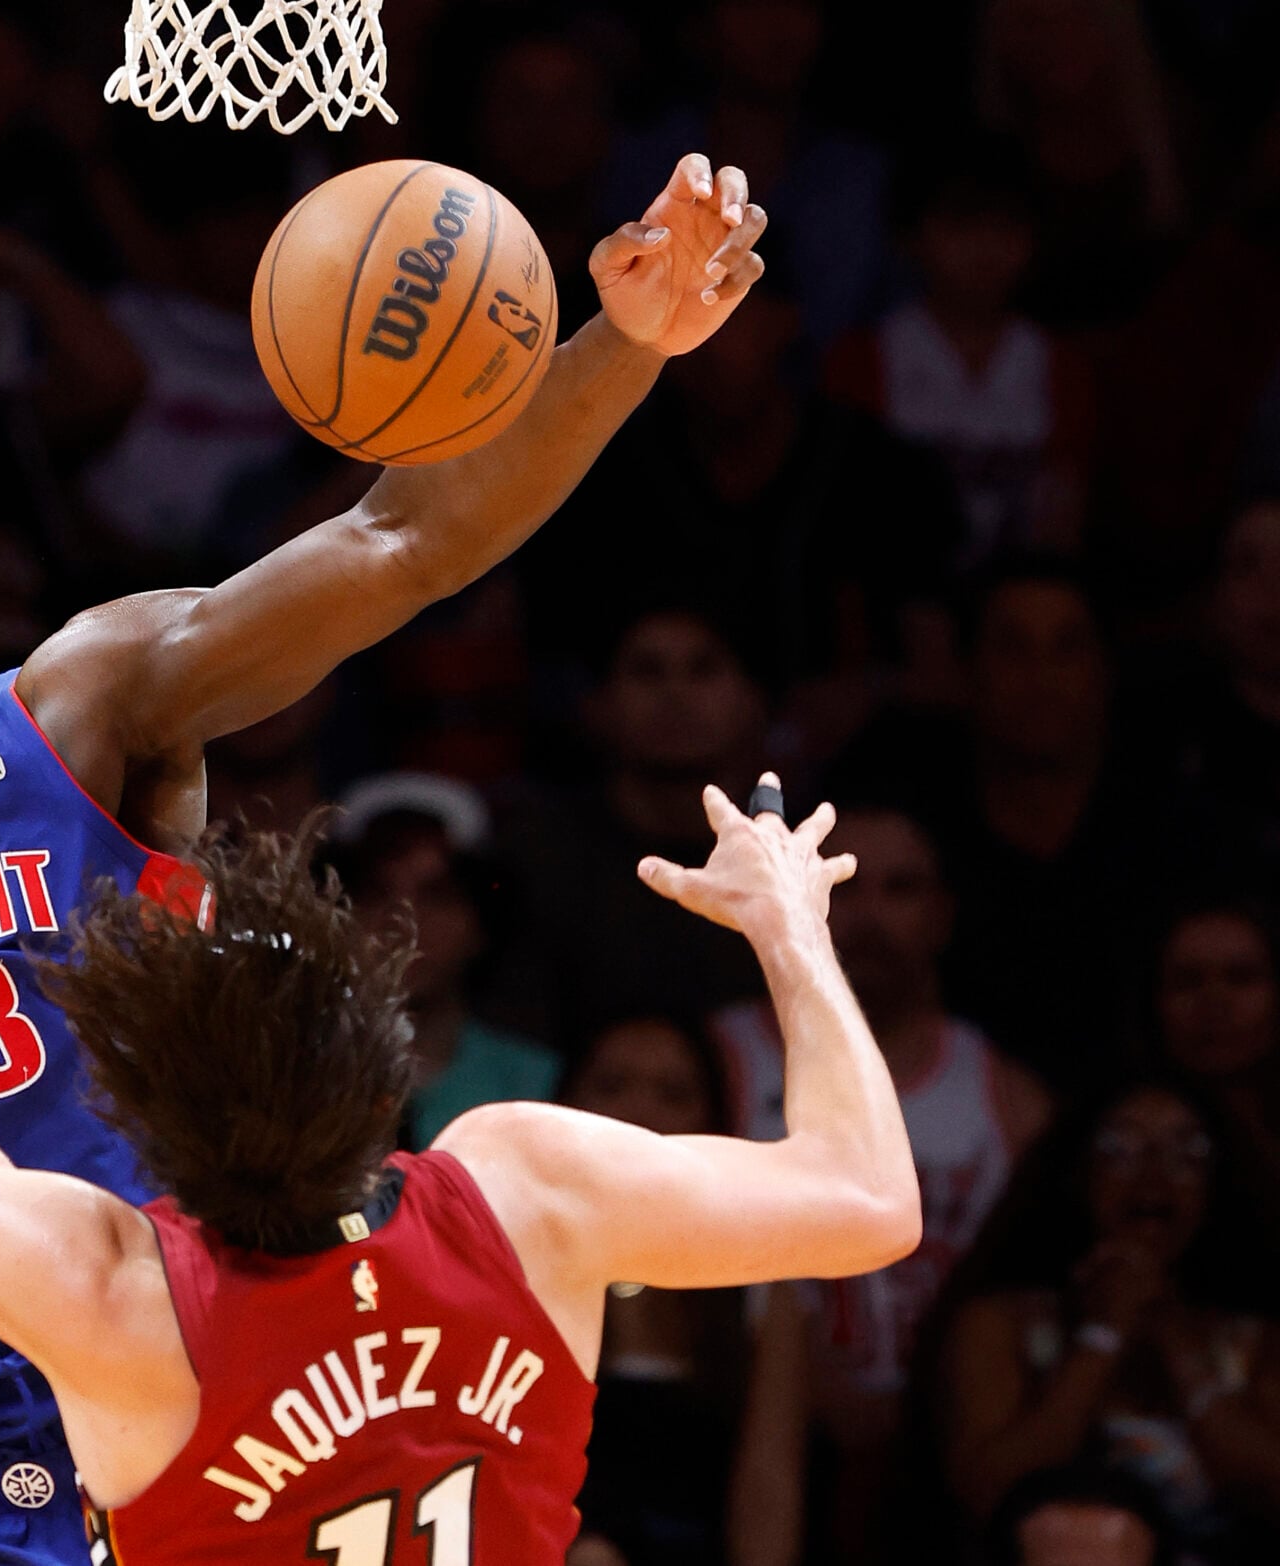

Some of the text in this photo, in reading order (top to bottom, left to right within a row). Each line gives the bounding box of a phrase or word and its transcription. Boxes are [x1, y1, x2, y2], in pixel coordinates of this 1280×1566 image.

[362, 187, 476, 361] Wilson
[202, 1327, 544, 1523] JAQUEZ JR.
